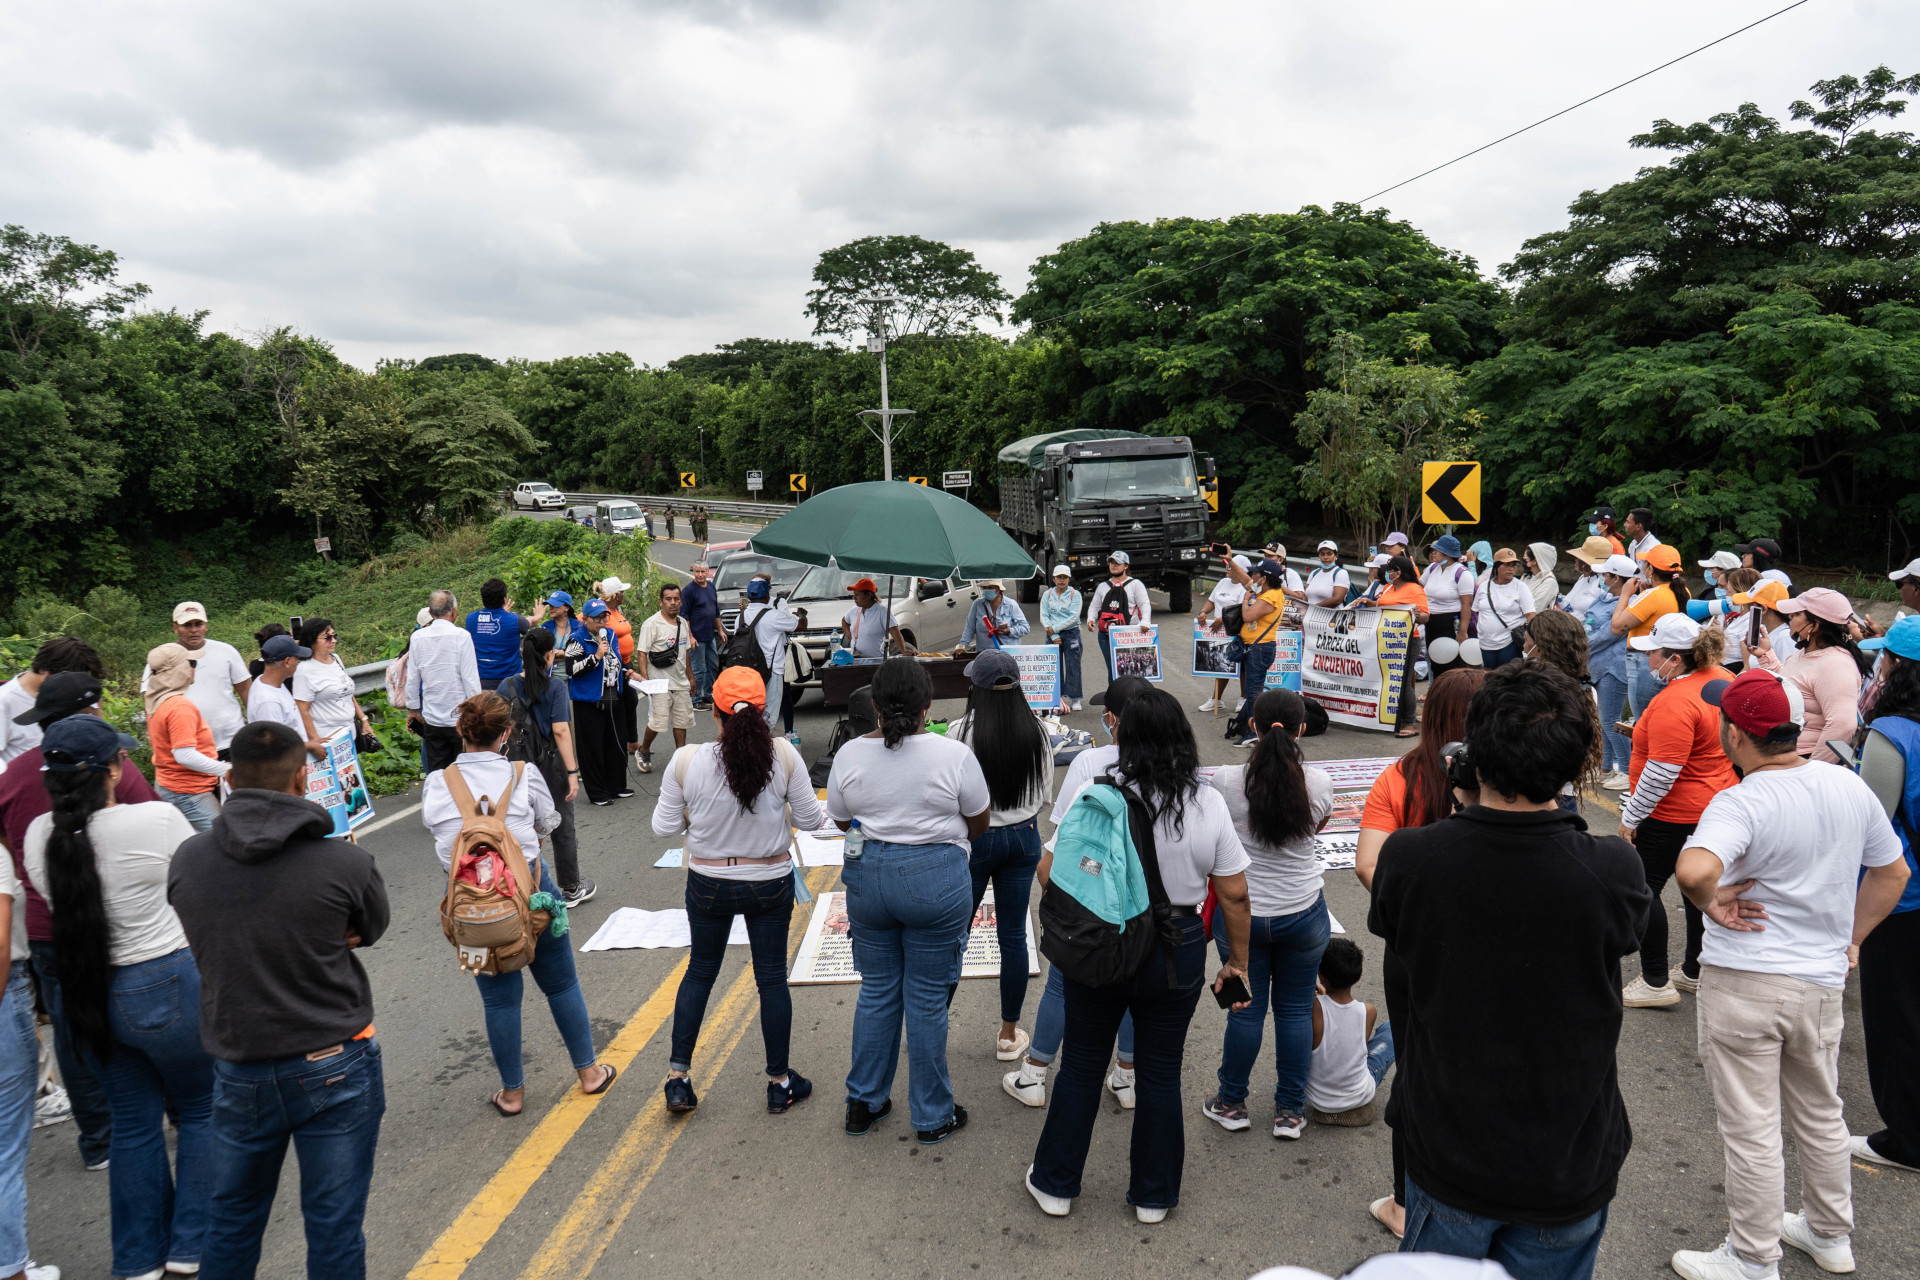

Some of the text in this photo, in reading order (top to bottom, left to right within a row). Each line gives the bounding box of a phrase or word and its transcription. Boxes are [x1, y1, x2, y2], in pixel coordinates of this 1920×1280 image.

[1316, 631, 1361, 655] CÁRCEL DEL
[1033, 654, 1057, 662] ENCUENTRO
[1291, 651, 1297, 659] NO
[1380, 650, 1402, 660] camina
[1032, 664, 1050, 672] RESPETO
[1276, 663, 1281, 671] EL
[1281, 663, 1300, 671] GOBIERNO
[1312, 653, 1364, 678] ENCUENTRO
[1038, 684, 1050, 692] VIVOS
